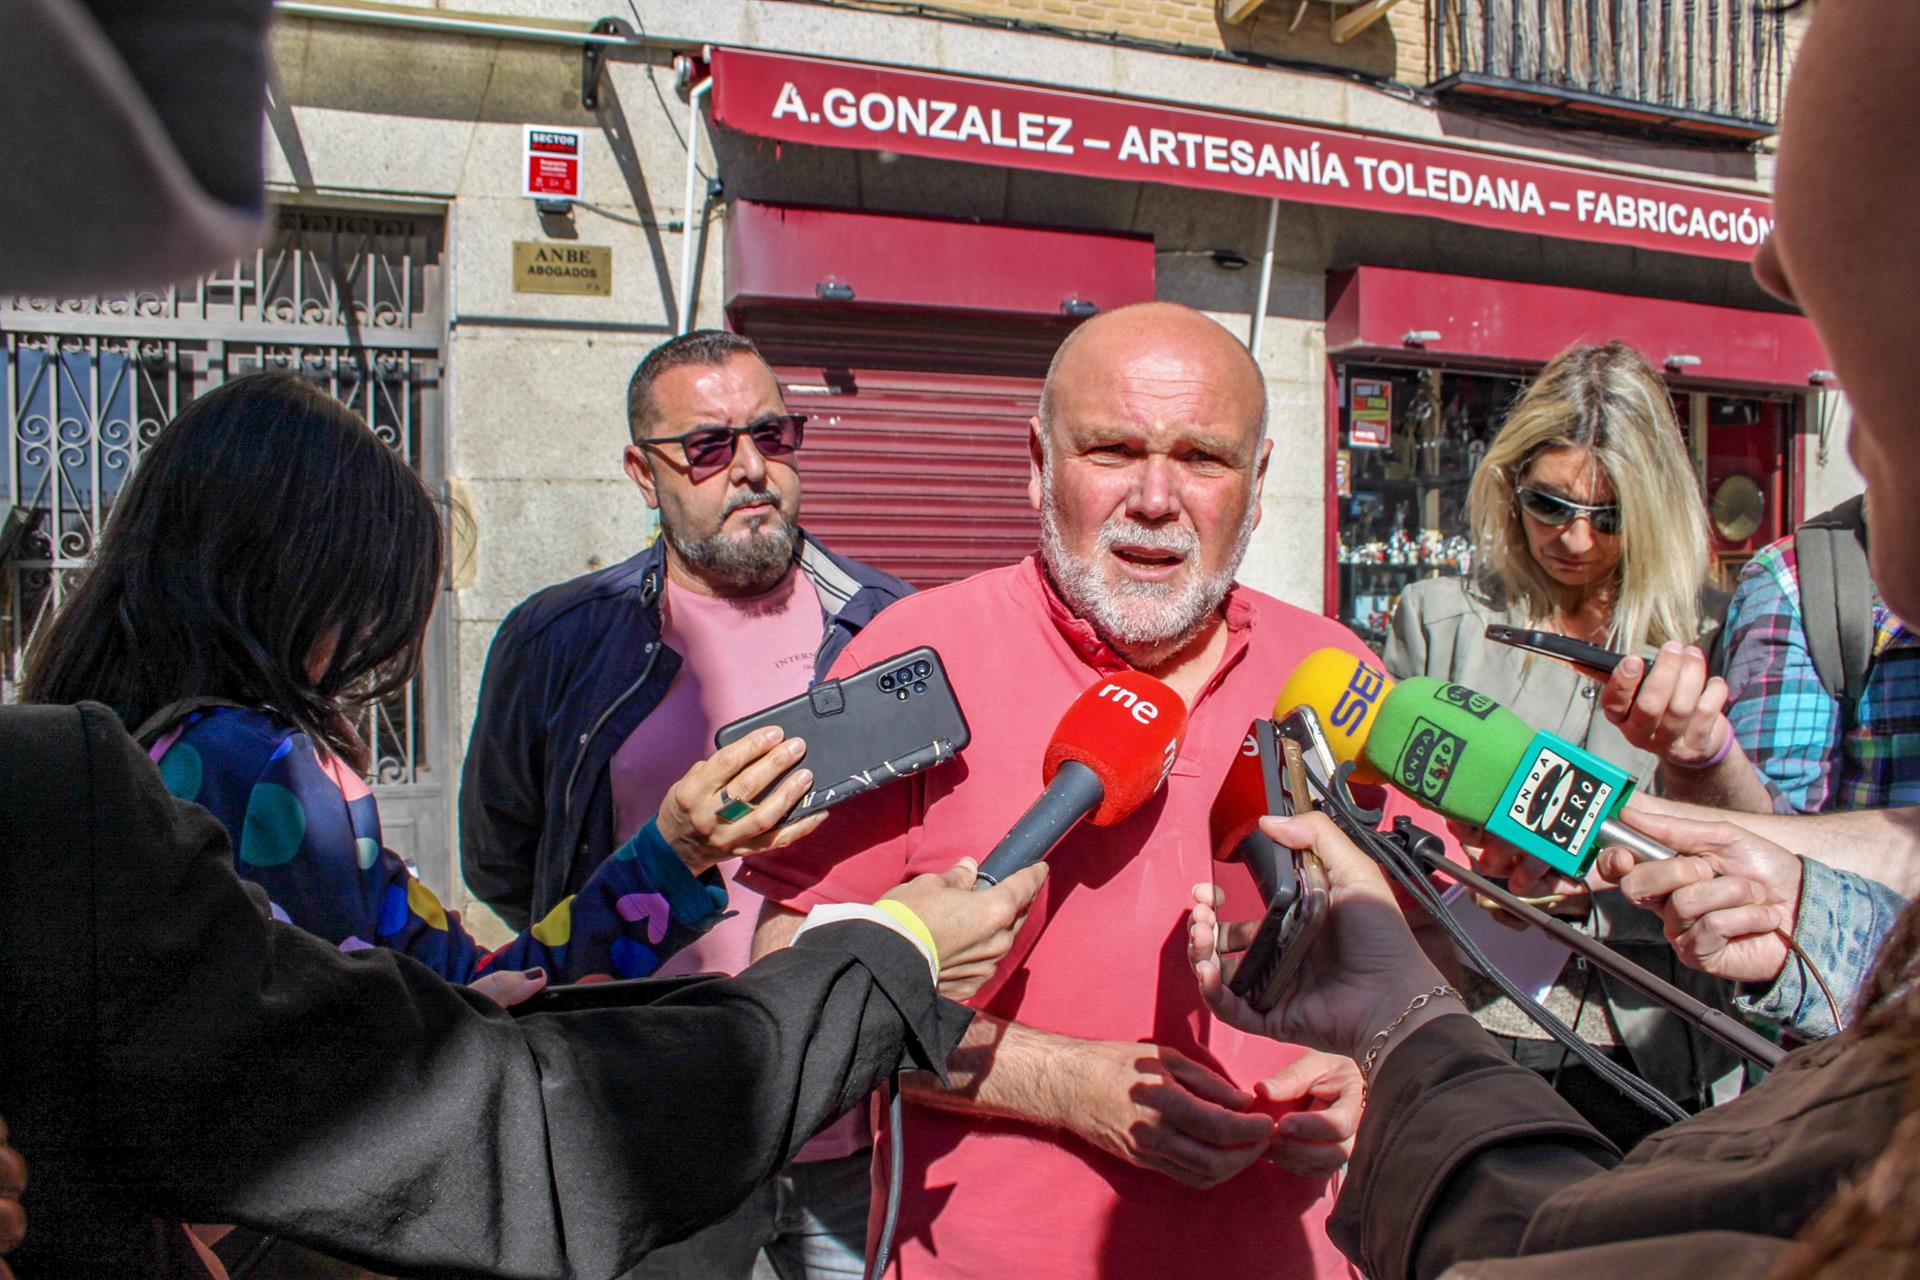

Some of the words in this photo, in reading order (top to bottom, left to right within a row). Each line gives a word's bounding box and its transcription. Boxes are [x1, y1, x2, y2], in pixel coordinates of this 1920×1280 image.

[532, 132, 575, 146] SECTOR
[772, 82, 1074, 154] A.GONZALEZ
[1118, 125, 1350, 188] ARTESANÍA
[1355, 155, 1545, 216] TOLEDANA
[528, 265, 597, 278] ABOGADOS
[535, 248, 591, 264] ANBE
[1098, 683, 1159, 724] rne
[1405, 735, 1432, 781] ONDA
[1514, 757, 1550, 814] ONDA
[1552, 780, 1594, 844] CERO
[1572, 788, 1607, 851] RADIO
